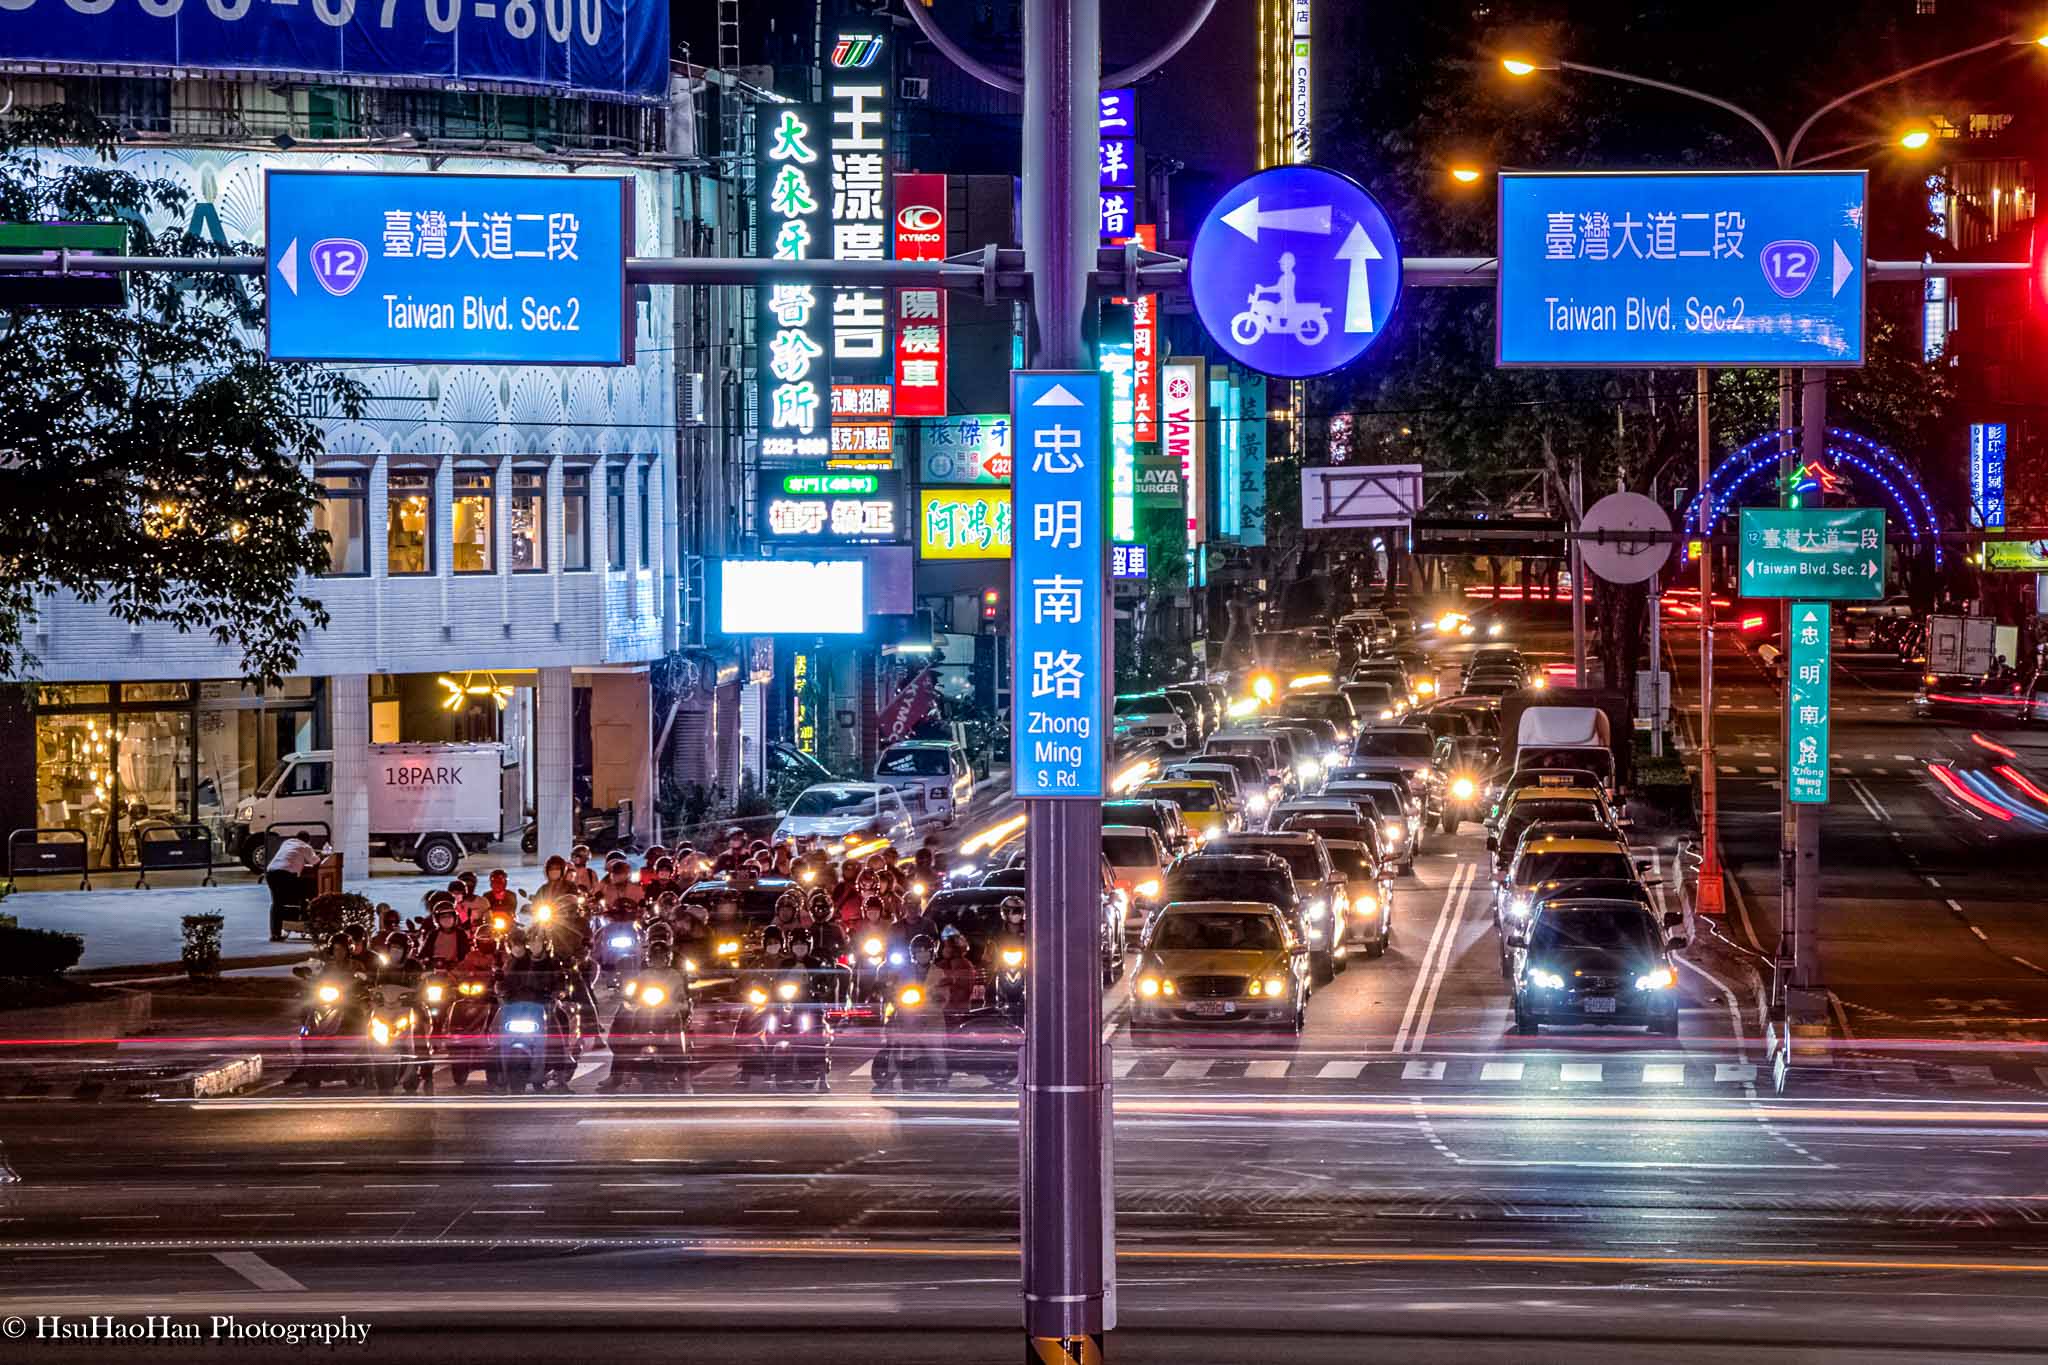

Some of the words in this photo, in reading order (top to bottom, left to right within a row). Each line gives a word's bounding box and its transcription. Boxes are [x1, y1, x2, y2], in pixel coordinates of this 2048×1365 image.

[383, 209, 580, 261] 臺灣大道二段
[899, 233, 940, 242] KYMCO
[1545, 211, 1745, 260] 臺灣大道二段
[322, 251, 357, 277] 12
[1772, 253, 1807, 278] 12
[383, 295, 454, 329] Taiwan
[463, 296, 513, 330] Blvd.
[521, 297, 580, 331] Sec.2
[901, 257, 939, 388] 陽機車
[1545, 297, 1616, 331] Taiwan
[1626, 297, 1676, 331] Blvd.
[1686, 297, 1745, 331] Sec.2
[1134, 469, 1178, 483] LAYA
[1762, 528, 1879, 549] 臺灣大道二段
[1031, 423, 1085, 699] 忠明南路
[1757, 562, 1797, 575] Taiwan
[1800, 562, 1829, 575] Blvd.
[1833, 562, 1857, 575] Sec.
[1798, 626, 1821, 765] 忠明南路
[1028, 711, 1090, 738] Zhong
[1034, 741, 1083, 768] Ming
[386, 767, 463, 785] 18PARK
[1037, 770, 1052, 788] S.
[1056, 770, 1080, 788] Rd.
